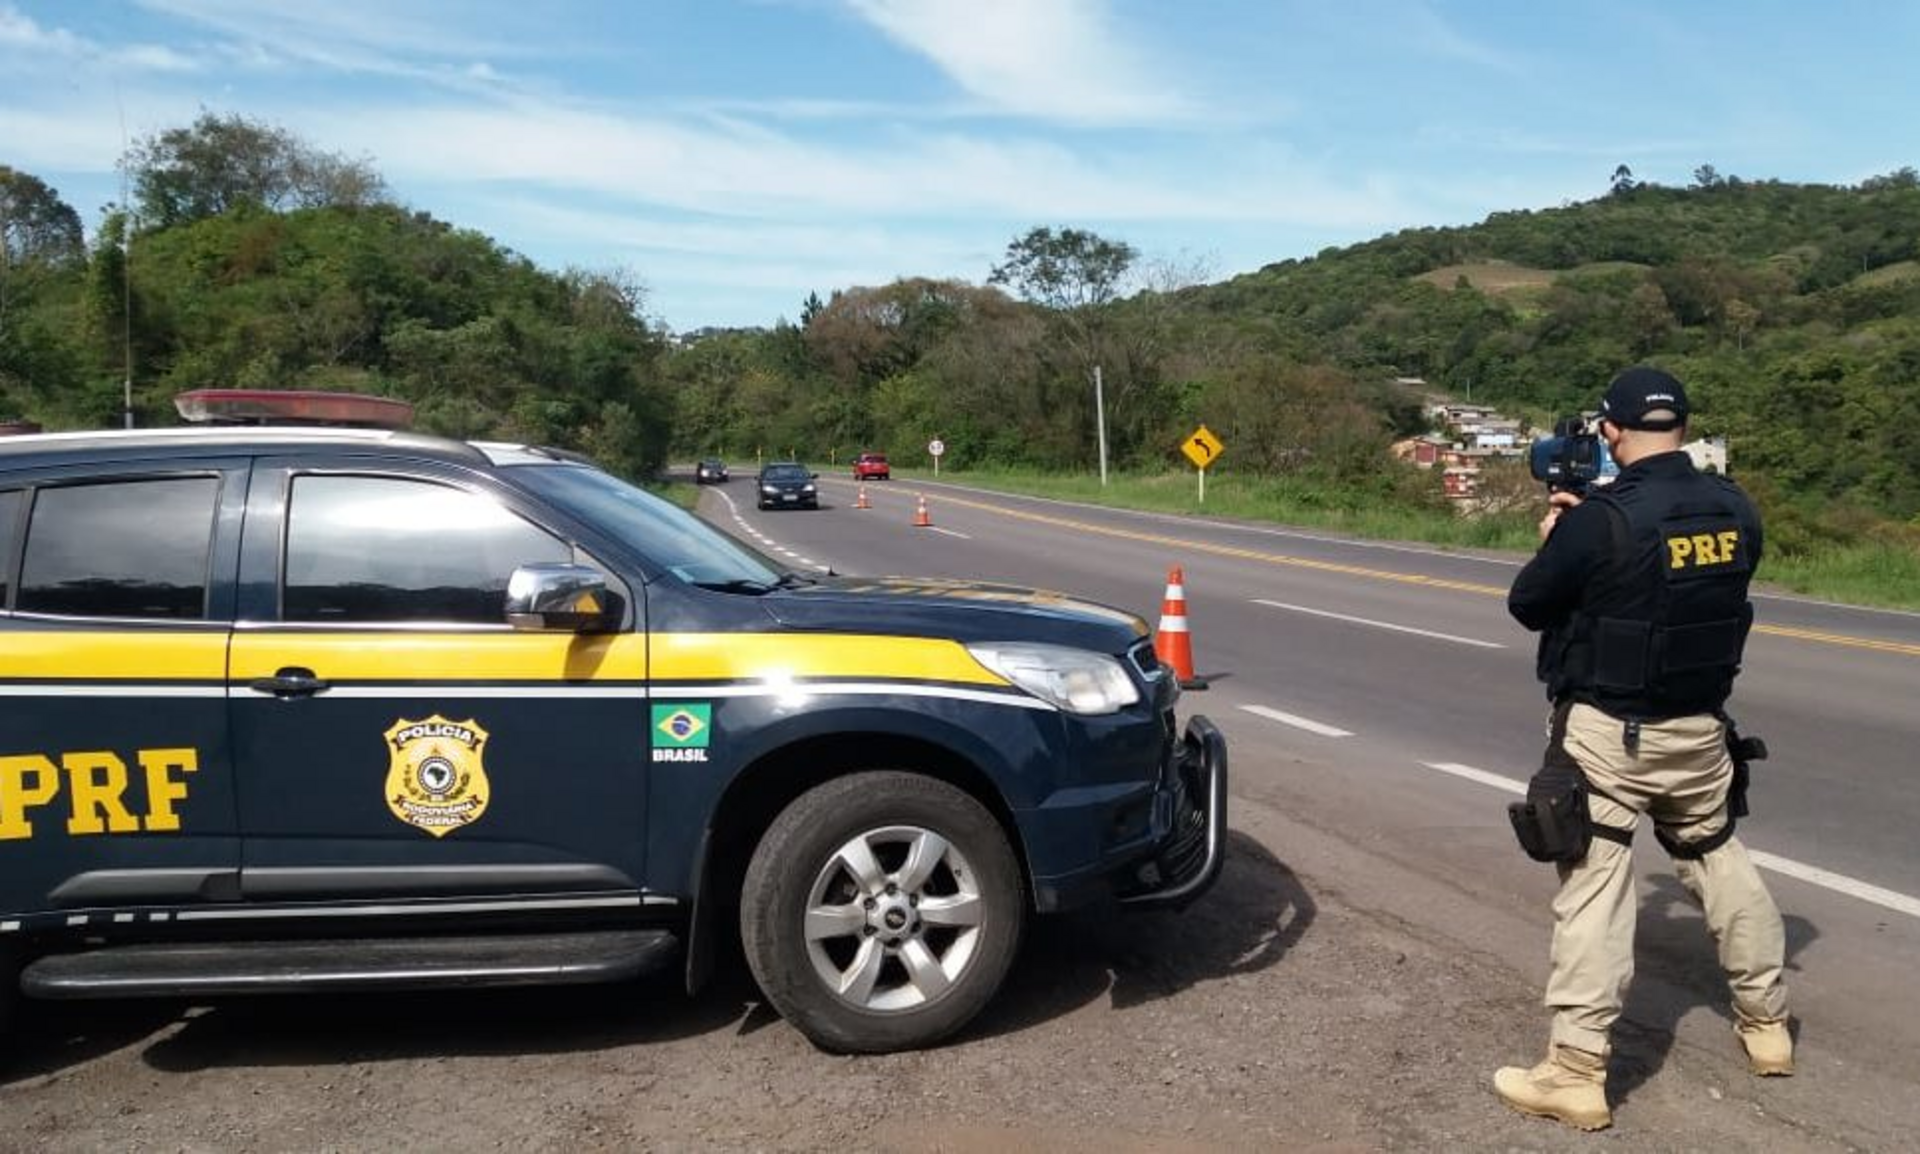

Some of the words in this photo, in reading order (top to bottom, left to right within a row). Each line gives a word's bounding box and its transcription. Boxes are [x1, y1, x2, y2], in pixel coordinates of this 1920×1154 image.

[1667, 531, 1738, 569] PRF
[653, 748, 708, 762] BRASIL
[0, 748, 198, 840] PRF
